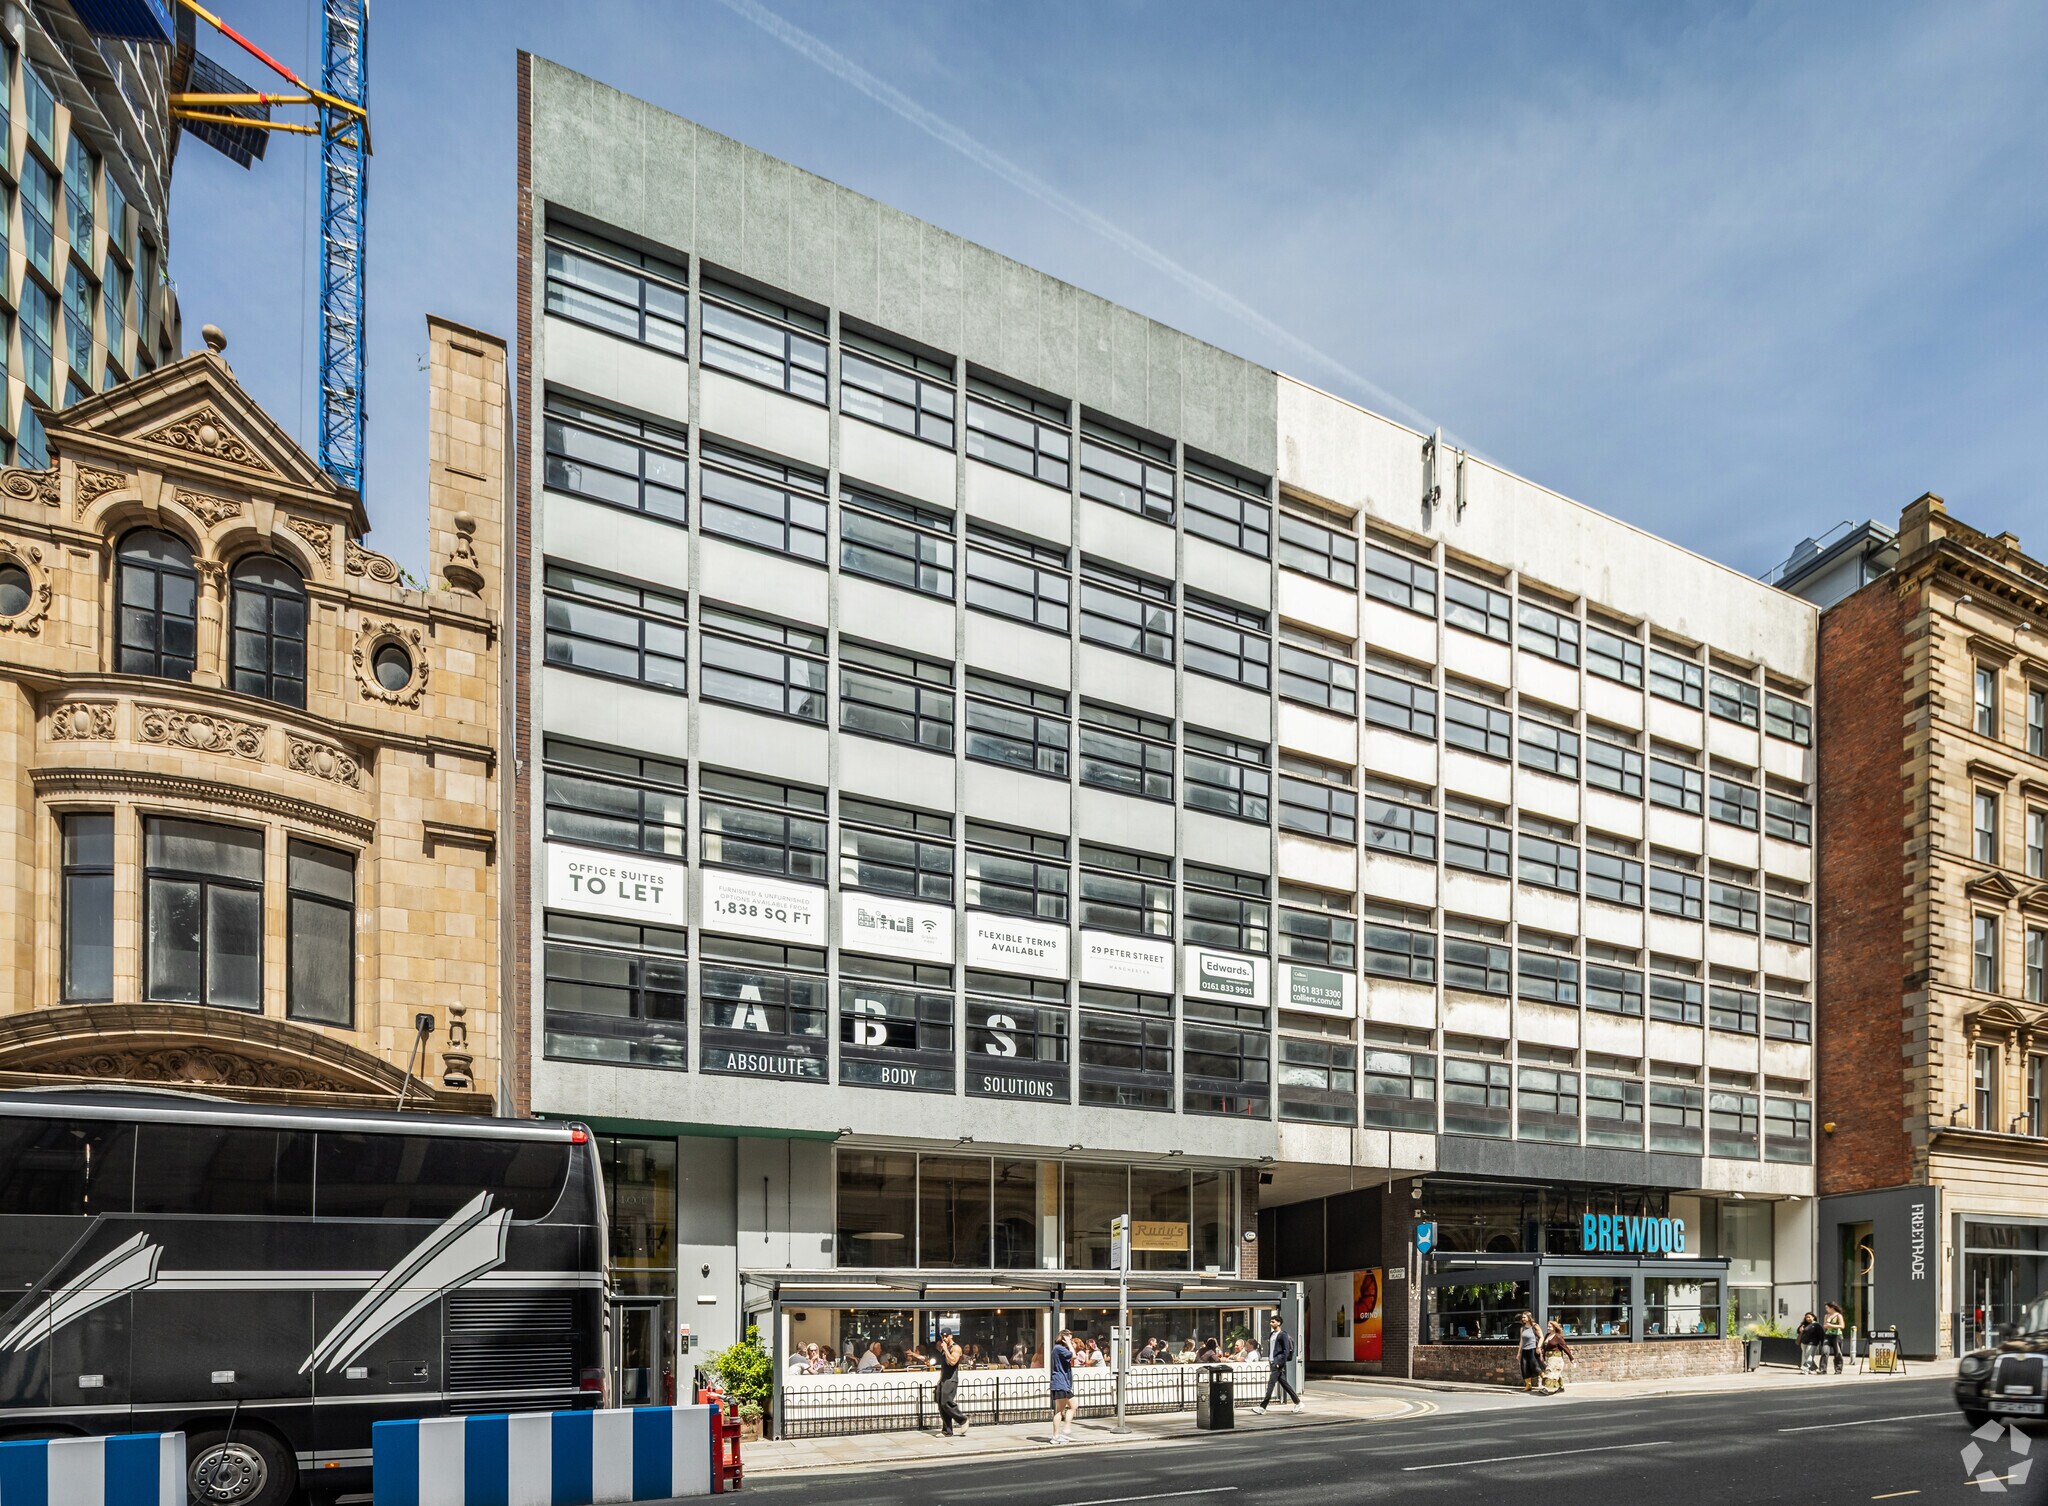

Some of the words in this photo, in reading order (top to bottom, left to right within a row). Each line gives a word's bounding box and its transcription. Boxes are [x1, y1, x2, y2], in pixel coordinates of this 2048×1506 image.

[568, 862, 616, 878] OFFICE
[621, 870, 664, 885] SUITES
[569, 874, 606, 895] TO
[619, 882, 664, 904] LET
[718, 886, 756, 897] FURNISHED
[764, 893, 810, 905] UNFURNISHED
[720, 893, 750, 903] OPTIONS
[752, 899, 787, 909] AVAILABLE
[714, 899, 758, 917] 1,838
[764, 907, 787, 923] SQ
[793, 912, 811, 925] FT
[978, 929, 1023, 944] FLEXIBLE
[1025, 936, 1057, 949] TERMS
[991, 943, 1045, 958] AVAILABLE
[1091, 945, 1102, 953] 29
[1103, 947, 1131, 958] PETER
[1133, 952, 1164, 963] STREET
[1206, 961, 1250, 976] Edwards.
[1202, 981, 1219, 990] 0161
[1220, 984, 1234, 993] 833
[1235, 986, 1252, 995] 9991
[1293, 984, 1309, 994] 0161
[1311, 986, 1323, 996] 831
[1325, 988, 1342, 999] 3300
[731, 985, 770, 1032] A
[1292, 993, 1341, 1007] colliers.com/uk
[854, 998, 887, 1046] B
[985, 1014, 1017, 1057] S
[727, 1053, 805, 1076] ABSOLUTE
[881, 1067, 917, 1085] BODY
[983, 1076, 1054, 1097] SOLUTIONS
[1135, 1224, 1184, 1240] Rudy's
[1583, 1213, 1685, 1253] BREWDOG
[1911, 1203, 1925, 1280] FREETRADE
[1875, 1348, 1890, 1357] BEER
[1875, 1357, 1890, 1366] HERE
